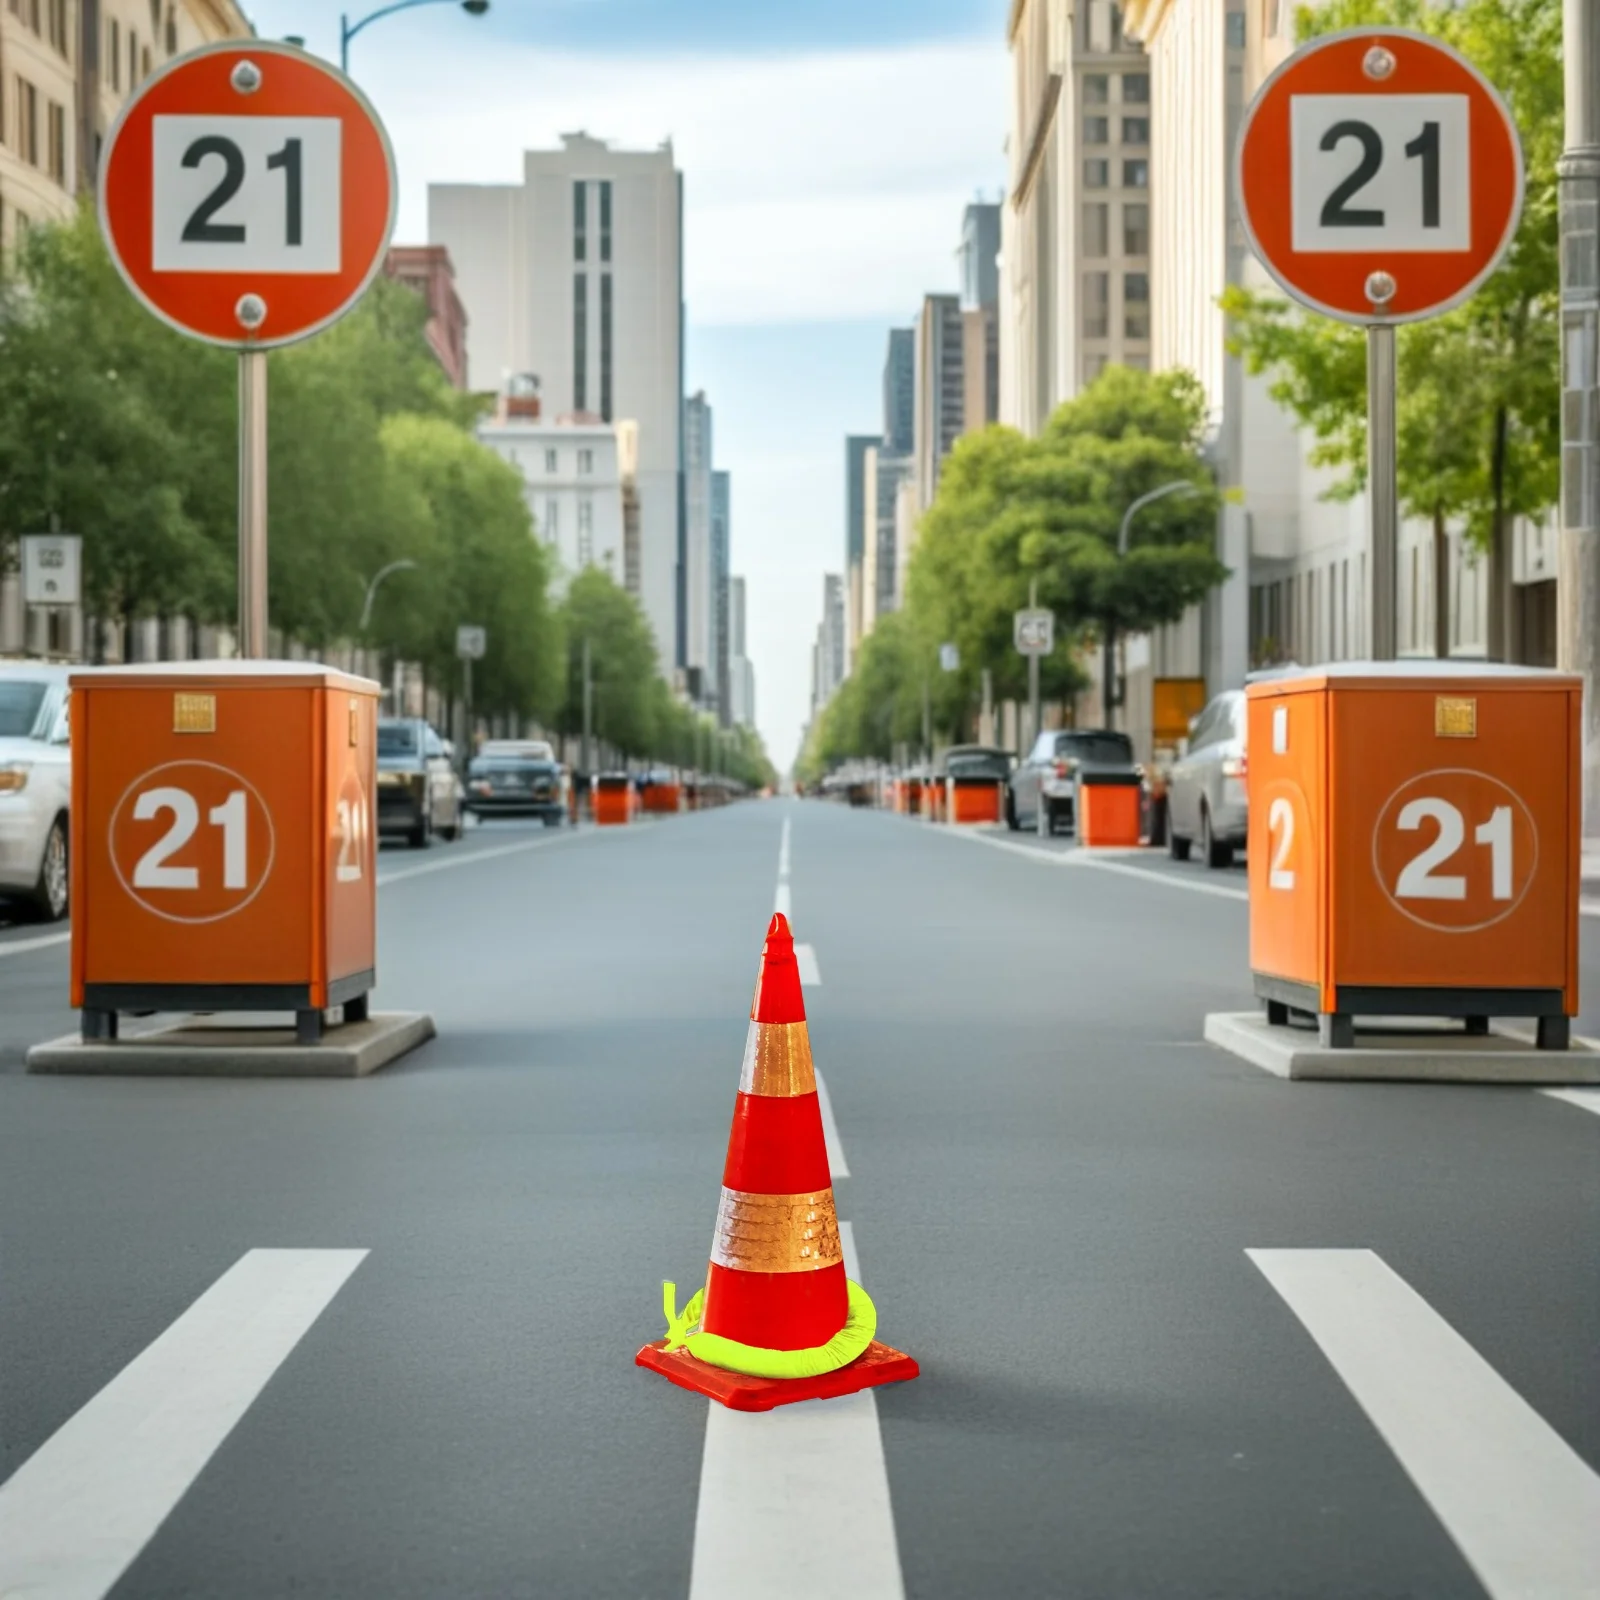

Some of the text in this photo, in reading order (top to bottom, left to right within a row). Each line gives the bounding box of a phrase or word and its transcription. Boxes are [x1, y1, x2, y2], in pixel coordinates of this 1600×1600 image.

[180, 134, 304, 246] 21
[1319, 120, 1442, 228] 21
[132, 787, 248, 890] 21
[1395, 796, 1513, 901] 21
